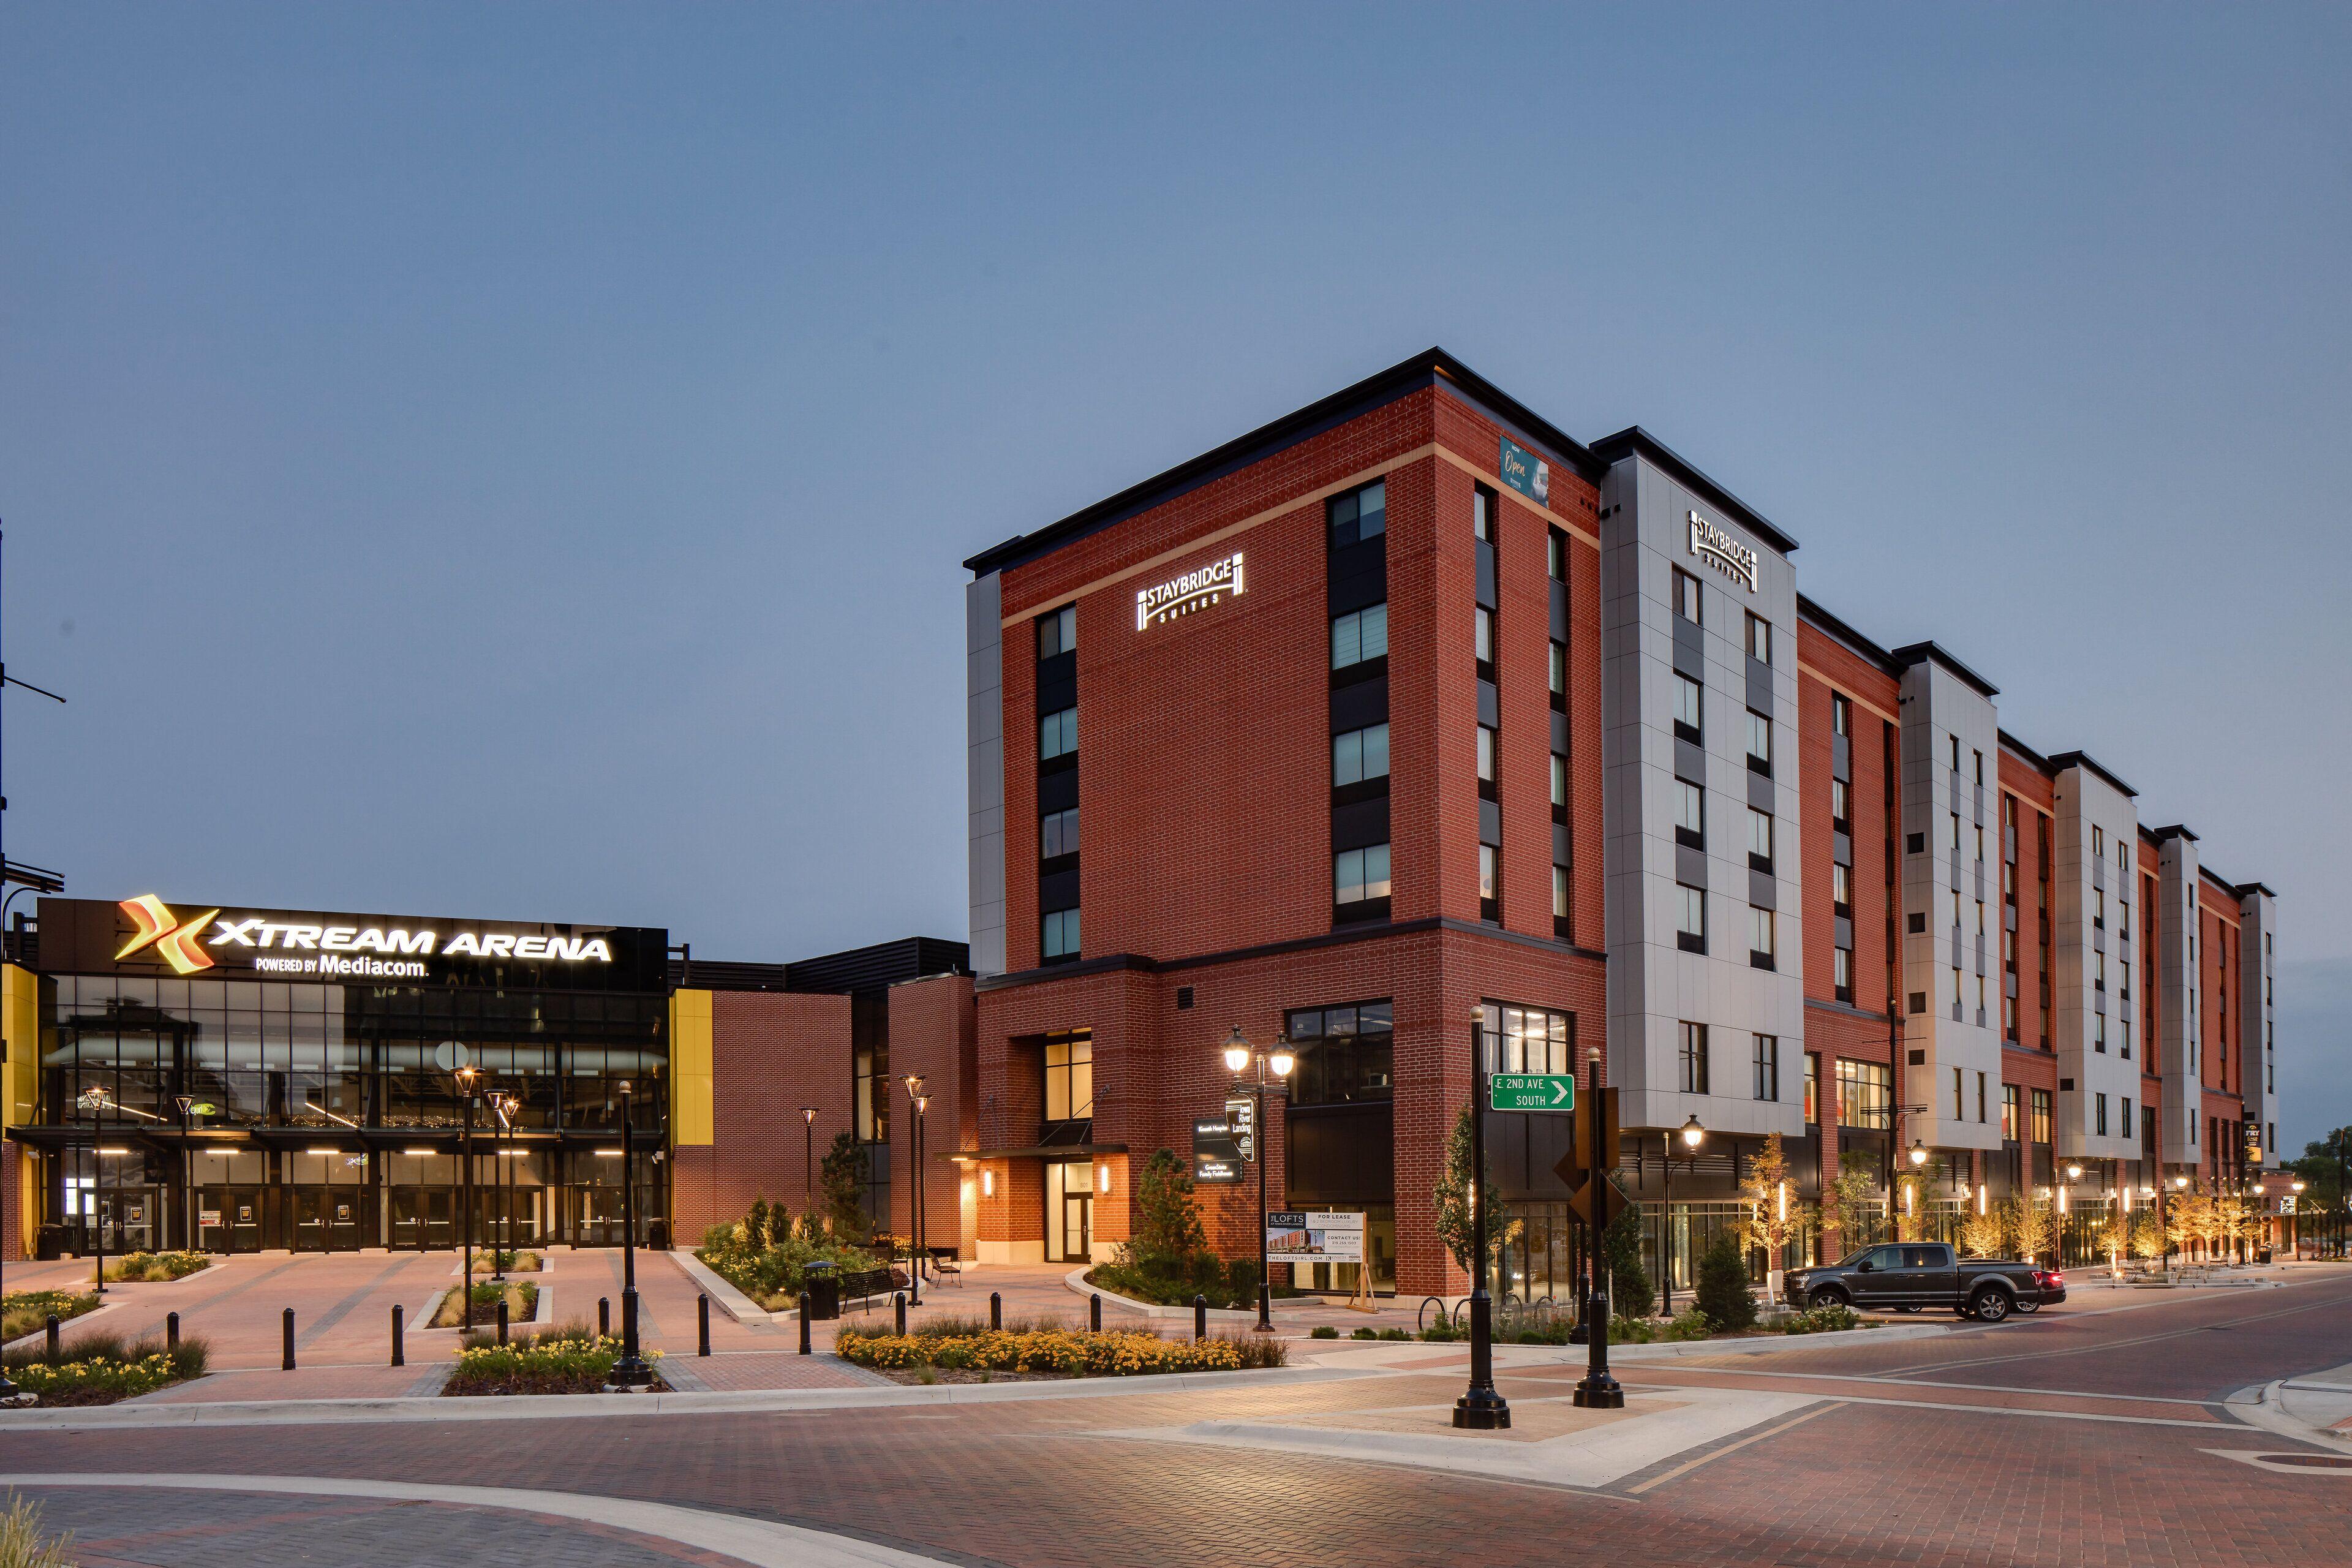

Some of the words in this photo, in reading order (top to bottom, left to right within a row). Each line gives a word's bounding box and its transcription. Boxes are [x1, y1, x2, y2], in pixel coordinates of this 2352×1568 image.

[1511, 445, 1520, 453] NOW
[1505, 451, 1525, 477] Open
[1698, 517, 1751, 568] STAYBRIDGE
[1704, 552, 1743, 584] SUITES
[1147, 559, 1232, 607] STAYBRIDGE
[1160, 593, 1219, 624] SUITES
[208, 919, 435, 954] XTREAM
[441, 933, 612, 962] ARENA
[255, 957, 303, 973] POWERED
[304, 959, 317, 973] BY
[319, 954, 424, 977] Mediacom
[1497, 1078, 1504, 1088] E.
[1507, 1079, 1524, 1089] 2ND
[1527, 1079, 1545, 1089] AVE.
[1240, 1104, 1251, 1114] Iowa
[1516, 1095, 1546, 1106] SOUTH
[1232, 1123, 1251, 1134] Landing
[1238, 1114, 1251, 1123] River
